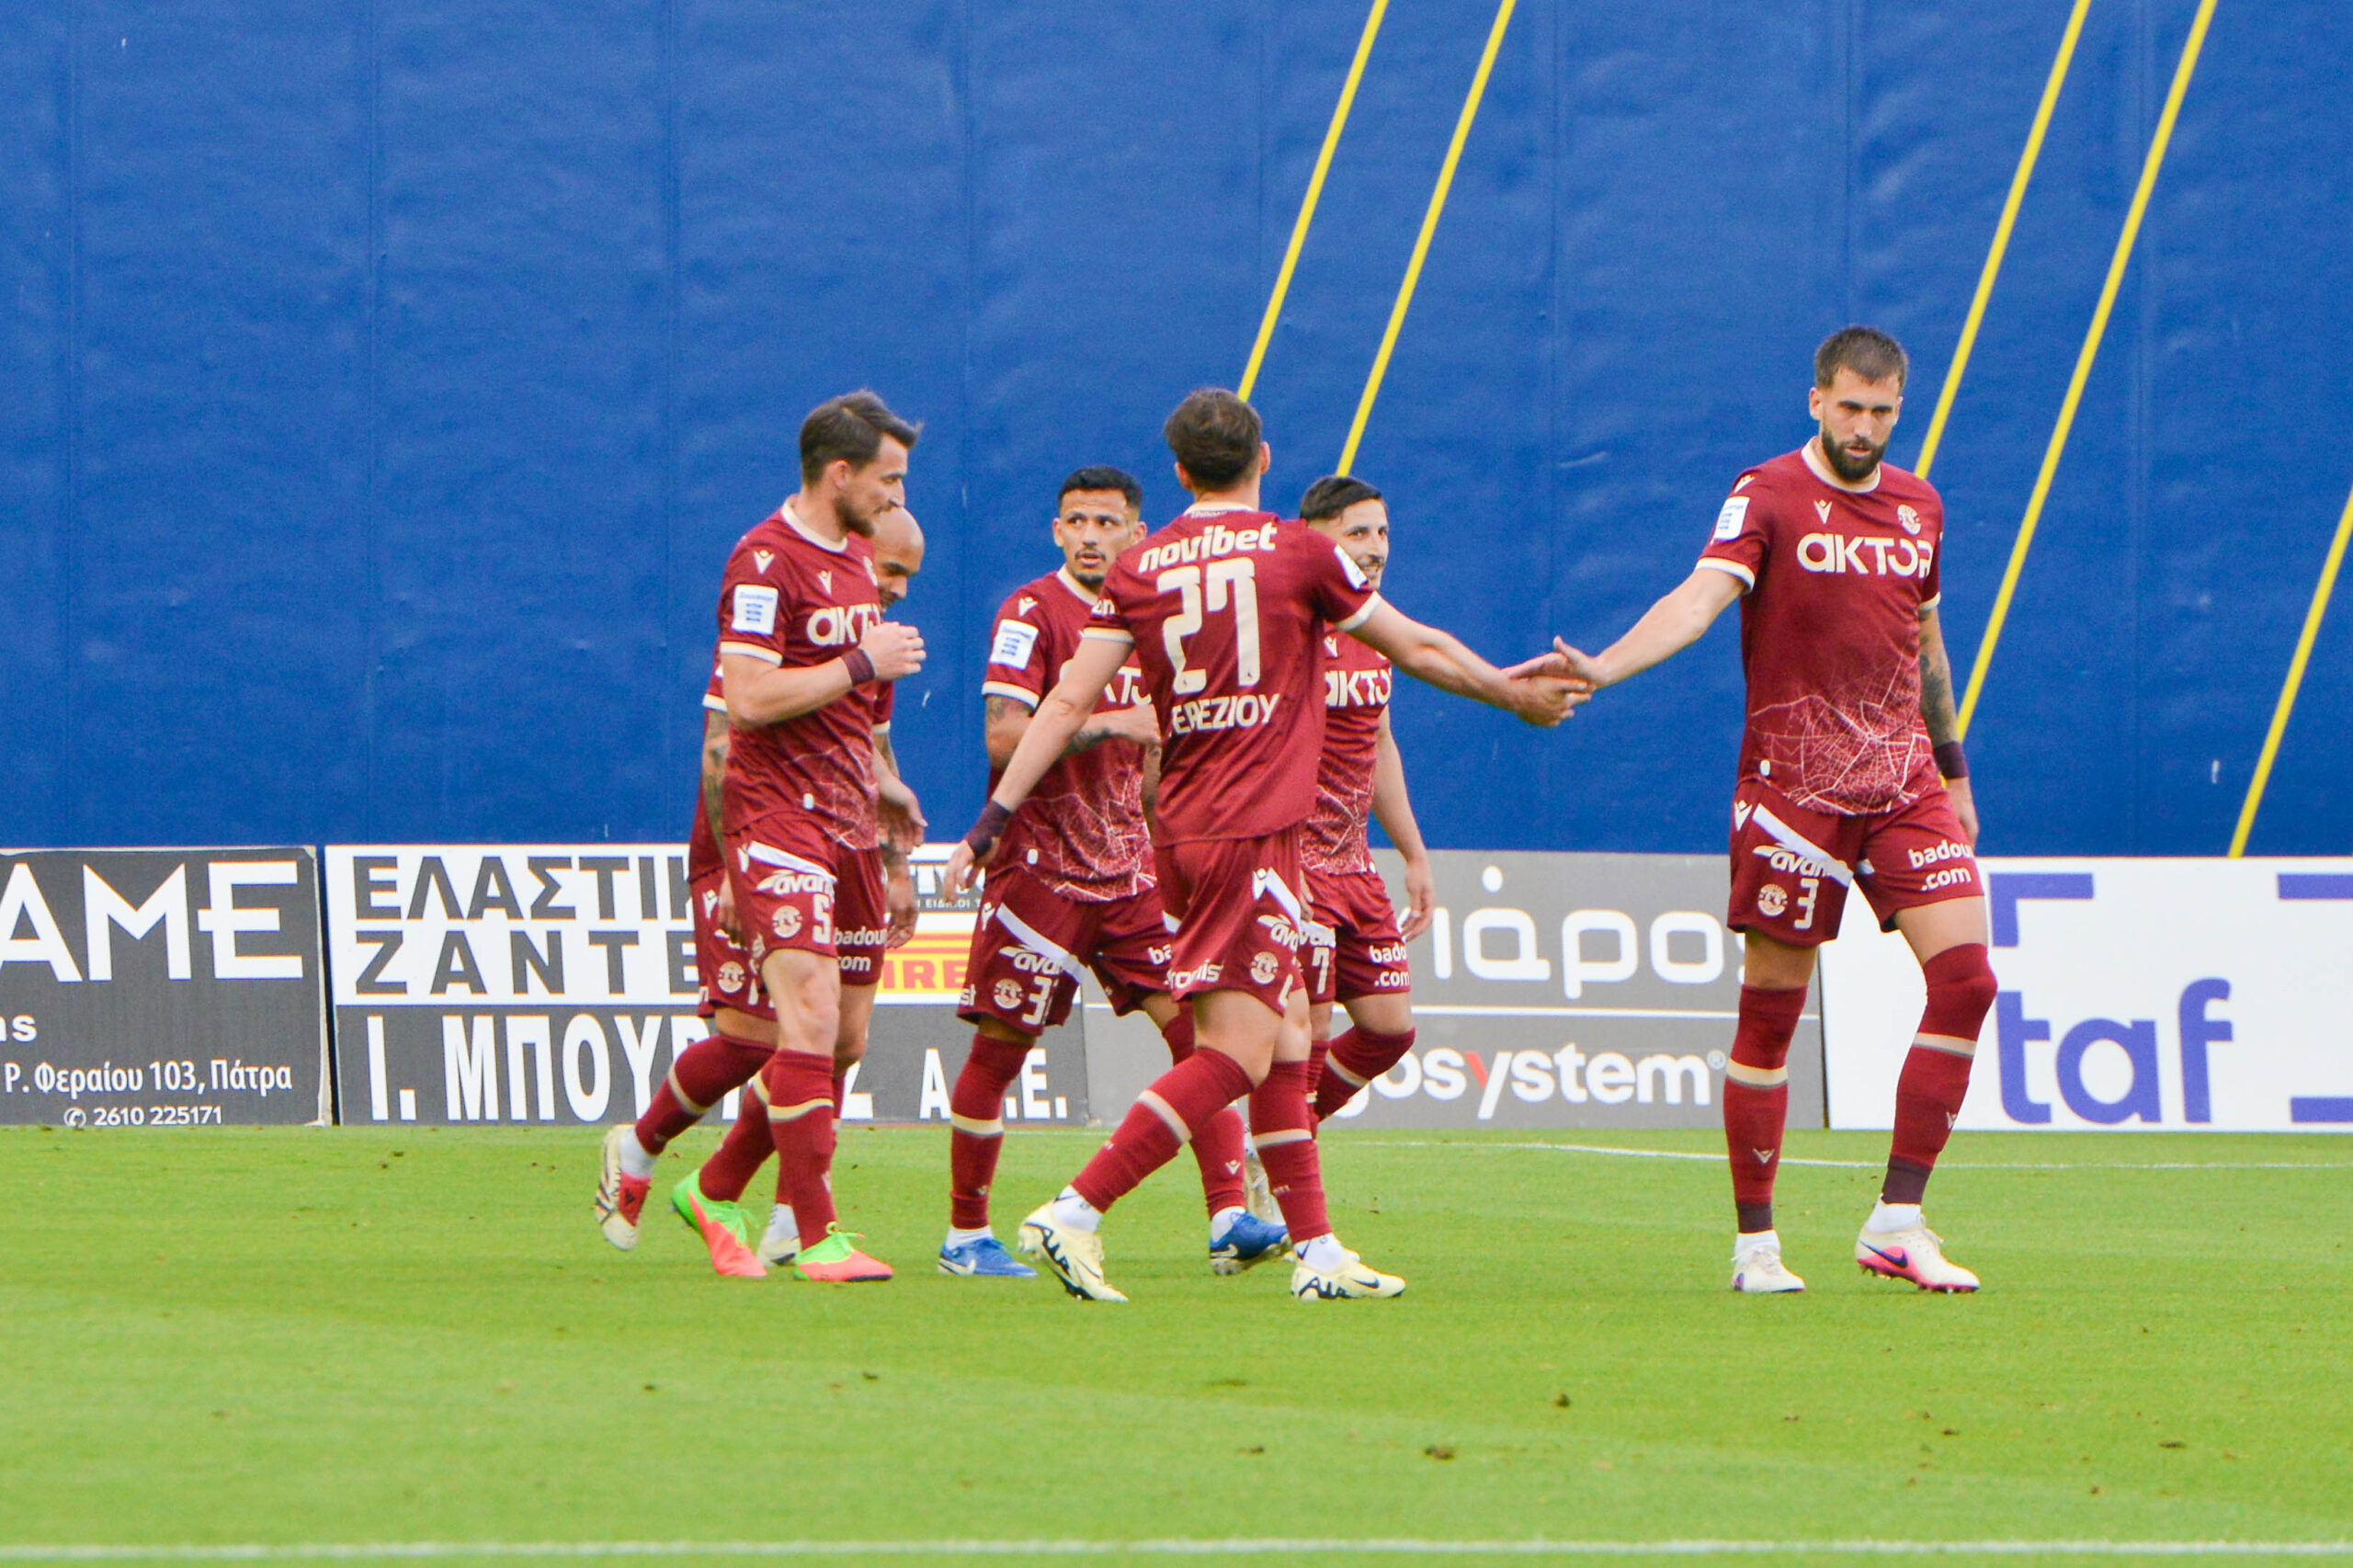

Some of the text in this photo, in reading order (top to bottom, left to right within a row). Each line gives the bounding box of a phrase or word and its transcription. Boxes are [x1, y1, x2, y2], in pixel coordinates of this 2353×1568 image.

[1138, 522, 1278, 574] novibet
[1156, 556, 1261, 696] 27
[1168, 693, 1280, 737] ΕΡΕΖΙΟΥ
[1793, 878, 1819, 929] 3
[1921, 868, 1972, 892] .com
[813, 893, 832, 944] 5
[1996, 978, 2234, 1123] taf
[34, 1061, 143, 1100] Φεραίου
[149, 1060, 206, 1096] 103,
[210, 1059, 292, 1097] Πάτρα
[94, 1106, 222, 1126] 2610 225171
